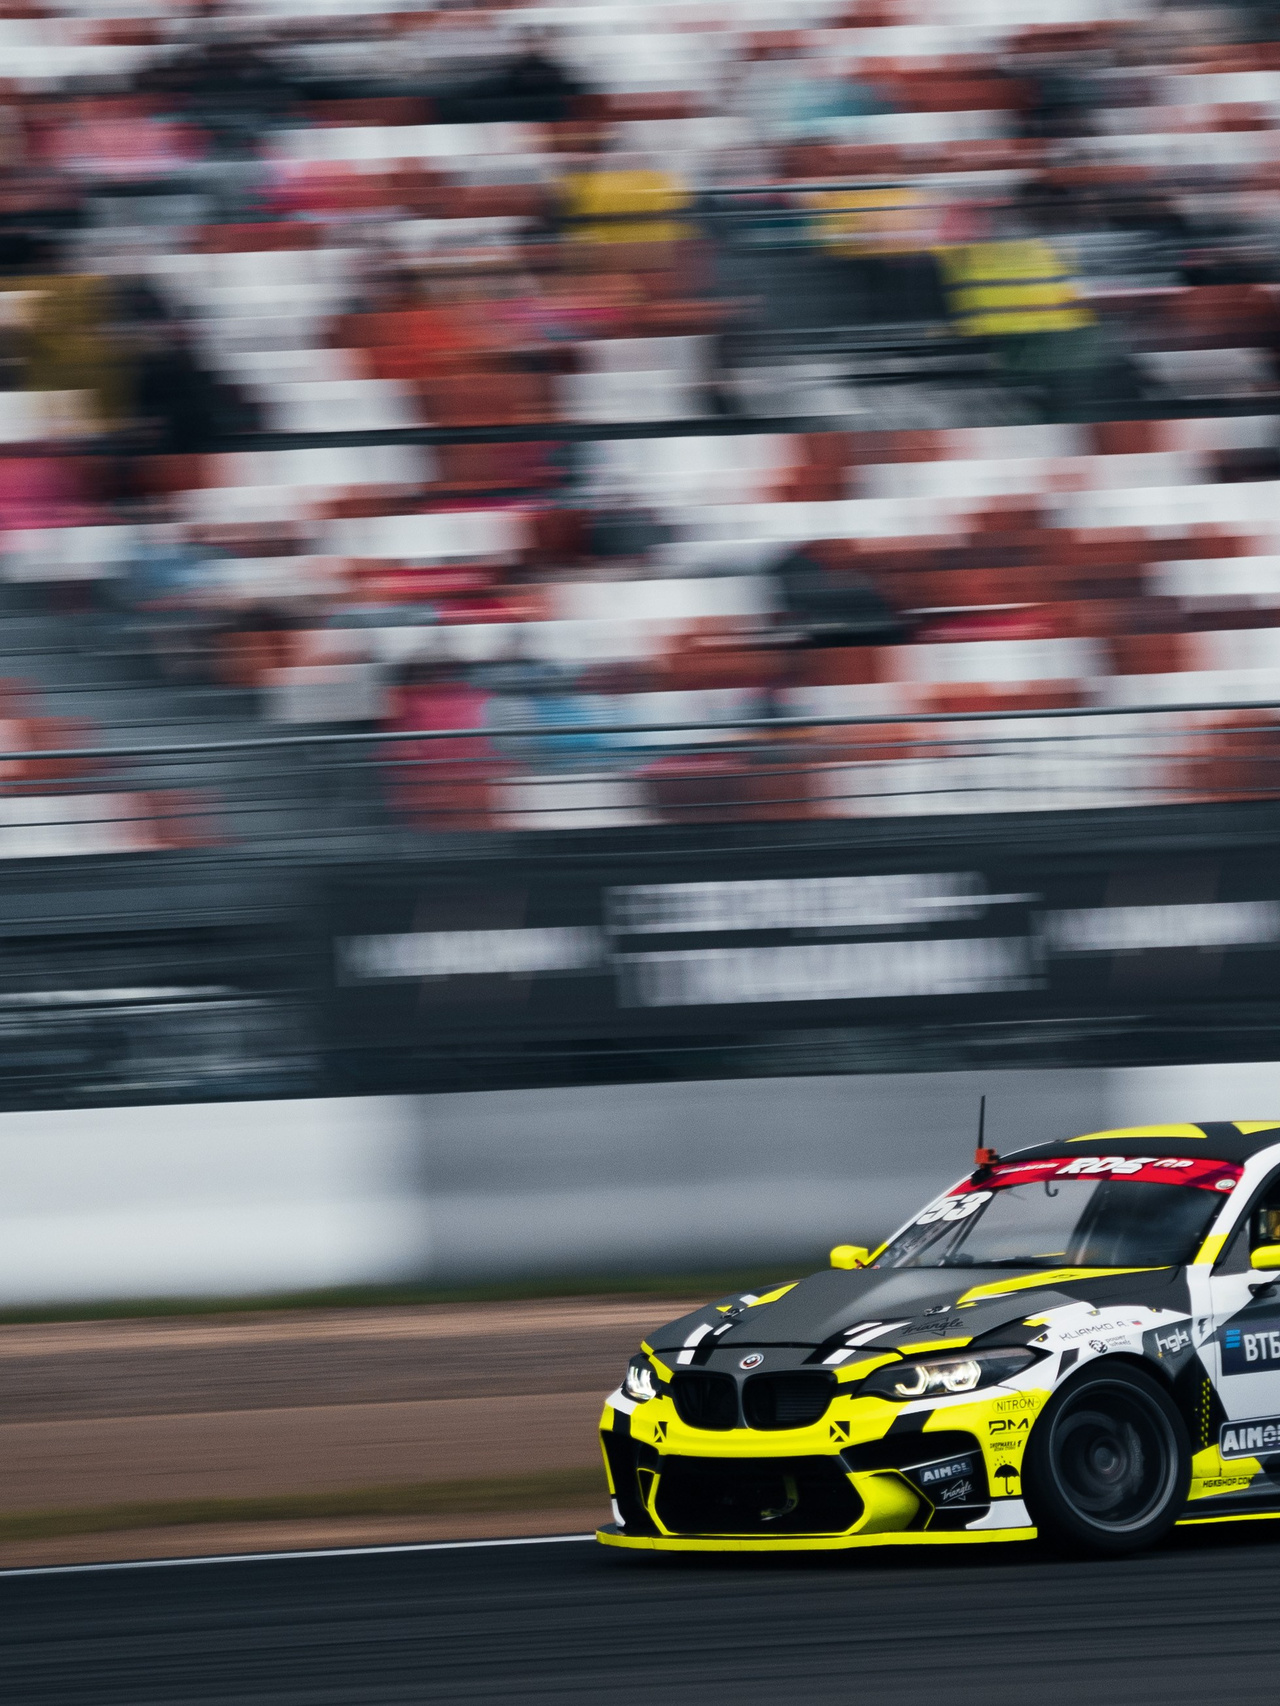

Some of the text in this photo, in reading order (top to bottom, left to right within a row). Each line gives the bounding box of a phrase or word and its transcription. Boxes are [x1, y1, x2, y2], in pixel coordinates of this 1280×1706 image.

[1055, 1157, 1160, 1175] RDS
[916, 1191, 993, 1226] 53
[901, 1318, 964, 1335] Triangle
[1059, 1323, 1114, 1341] KLIAMKO
[1155, 1328, 1189, 1352] hgk
[996, 1398, 1036, 1412] NITRON
[923, 1462, 970, 1482] AIMOL
[941, 1481, 973, 1500] Triangle
